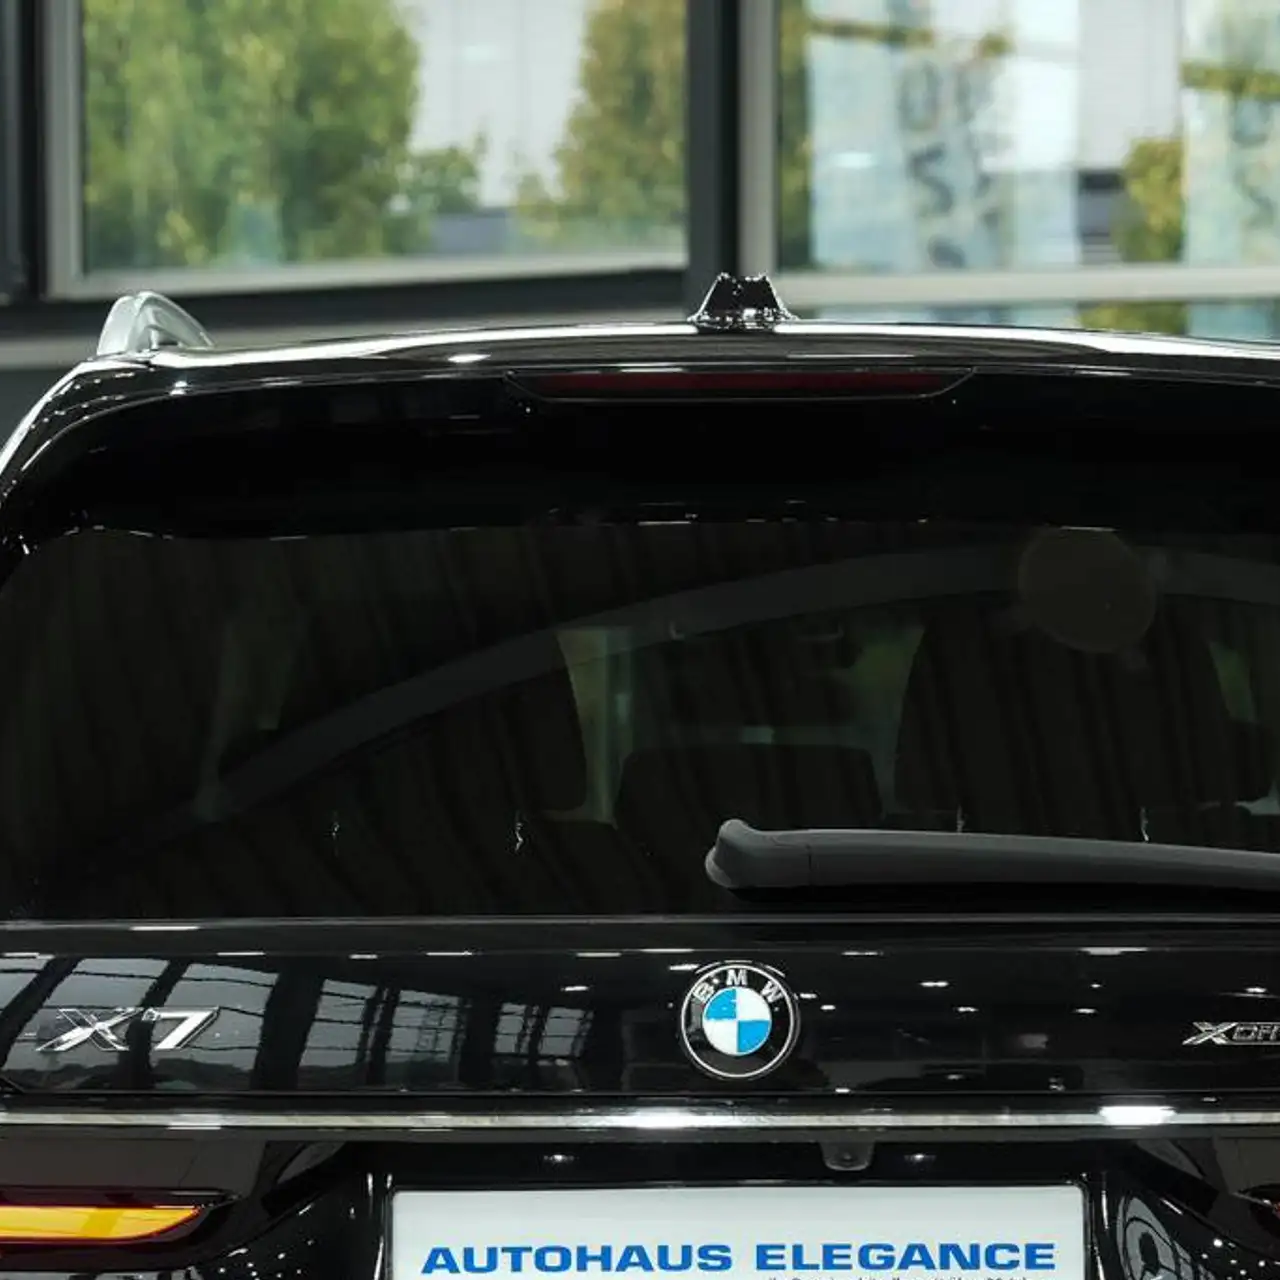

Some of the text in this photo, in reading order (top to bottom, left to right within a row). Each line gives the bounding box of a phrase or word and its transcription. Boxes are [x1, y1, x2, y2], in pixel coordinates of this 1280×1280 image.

[692, 969, 783, 1003] BMW
[36, 1006, 220, 1051] X7
[420, 1242, 1056, 1274] AUTOHAUS ELEGANCE
